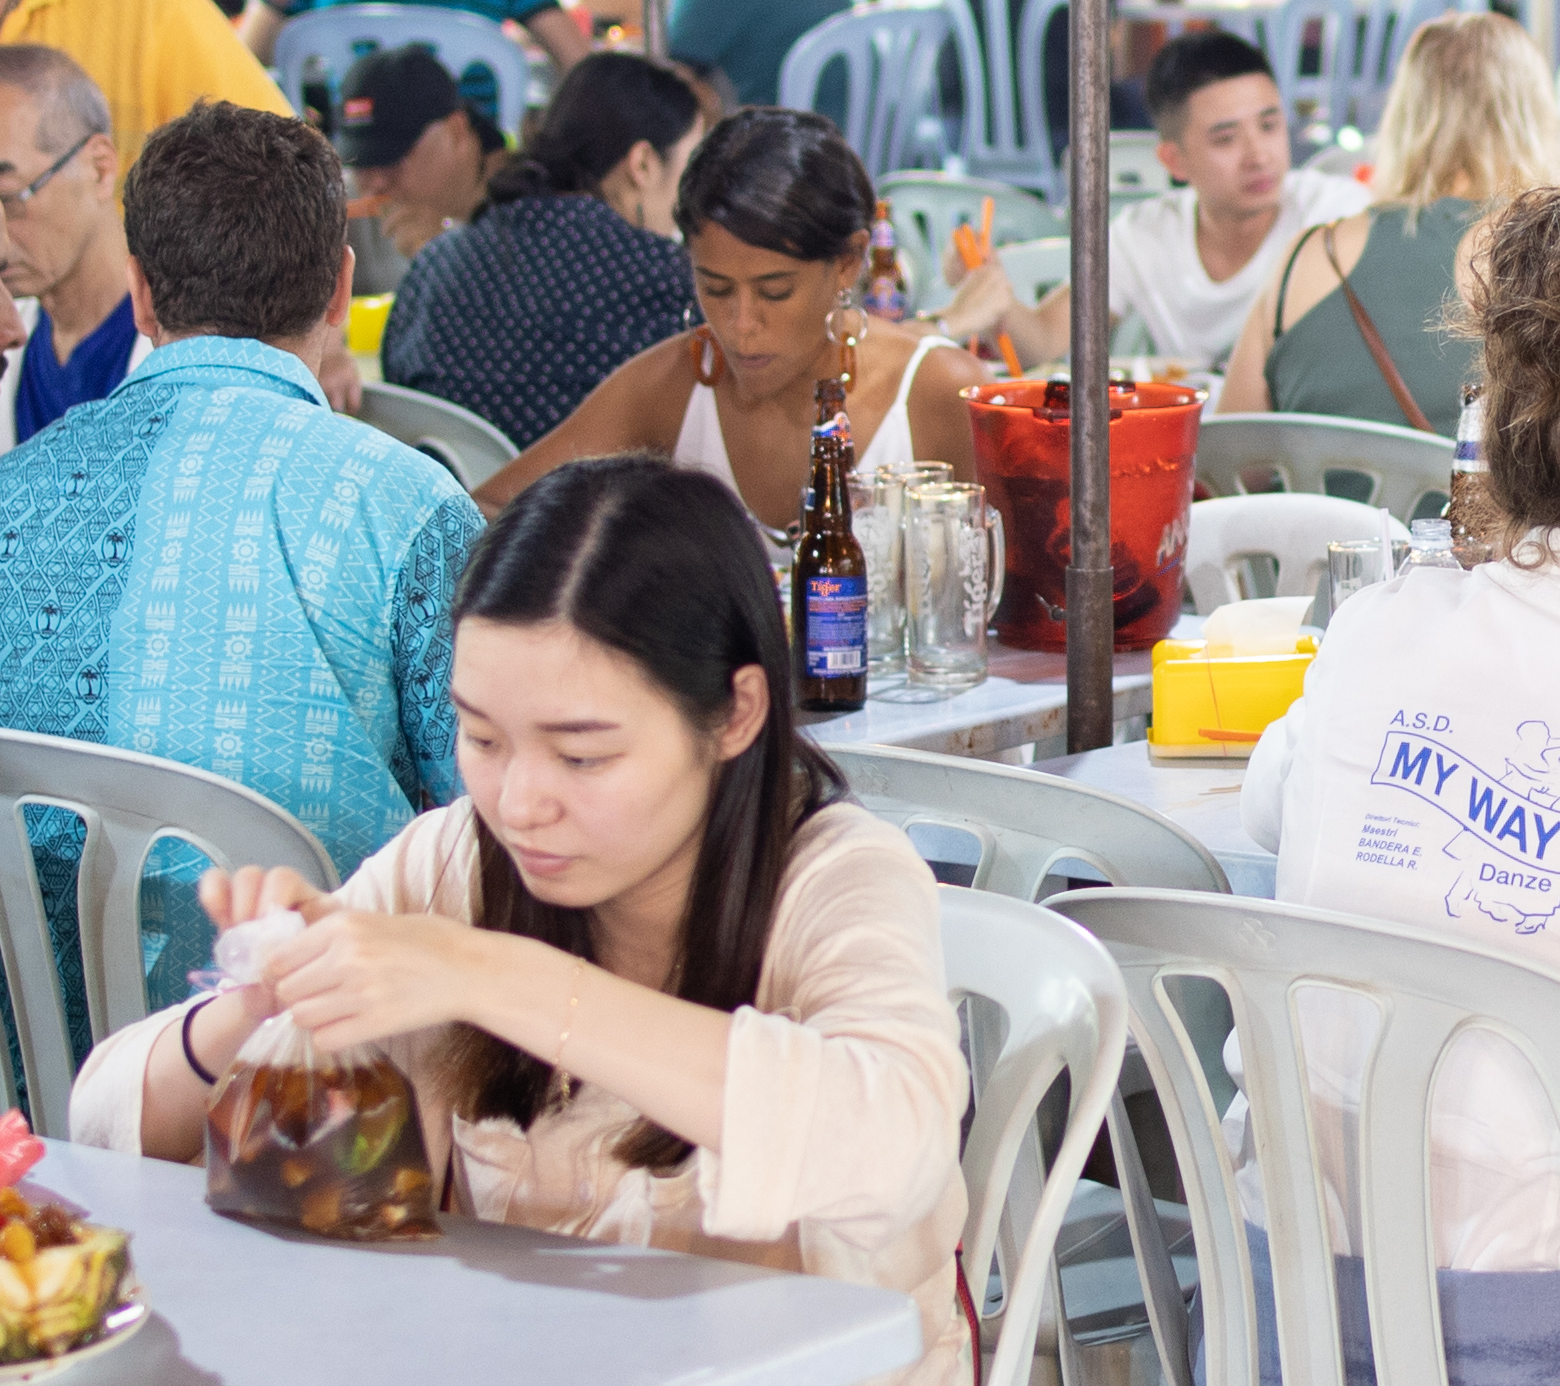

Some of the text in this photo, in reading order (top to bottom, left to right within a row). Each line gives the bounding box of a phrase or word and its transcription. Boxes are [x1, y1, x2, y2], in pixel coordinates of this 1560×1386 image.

[810, 579, 842, 598] Tiger
[1389, 709, 1454, 733] A.S.D.
[1388, 741, 1460, 796] MY
[1358, 837, 1409, 854] BANDERA
[1356, 851, 1418, 870] RODELLA R.
[1479, 863, 1552, 893] Danze
